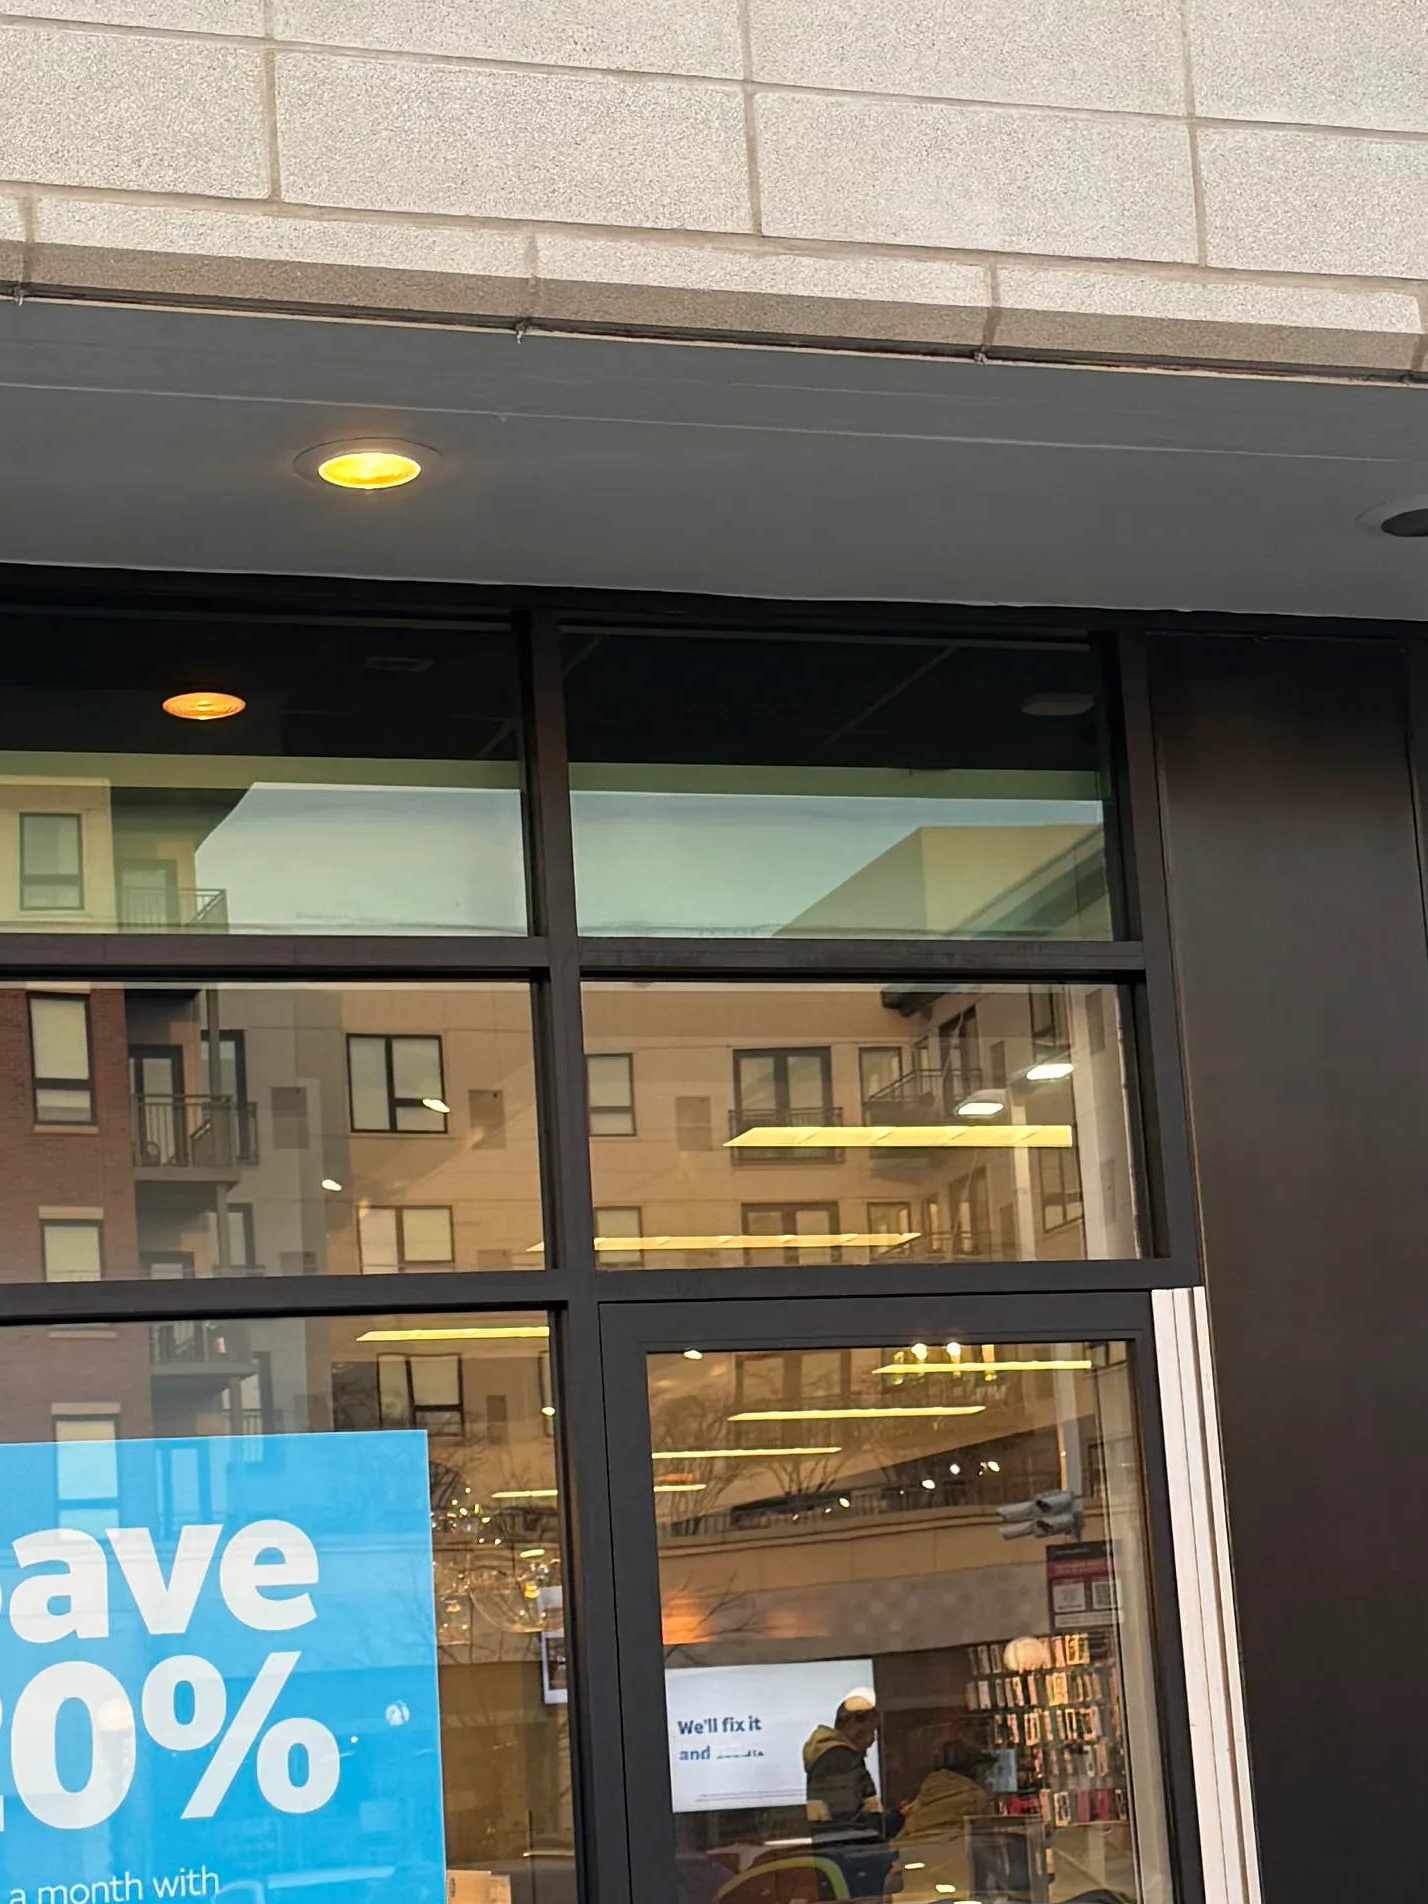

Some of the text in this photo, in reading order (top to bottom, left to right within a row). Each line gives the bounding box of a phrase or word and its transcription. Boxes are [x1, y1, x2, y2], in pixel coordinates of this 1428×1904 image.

[677, 1715, 762, 1734] We'll fix it
[679, 1745, 710, 1760] and
[152, 1864, 220, 1898] with
